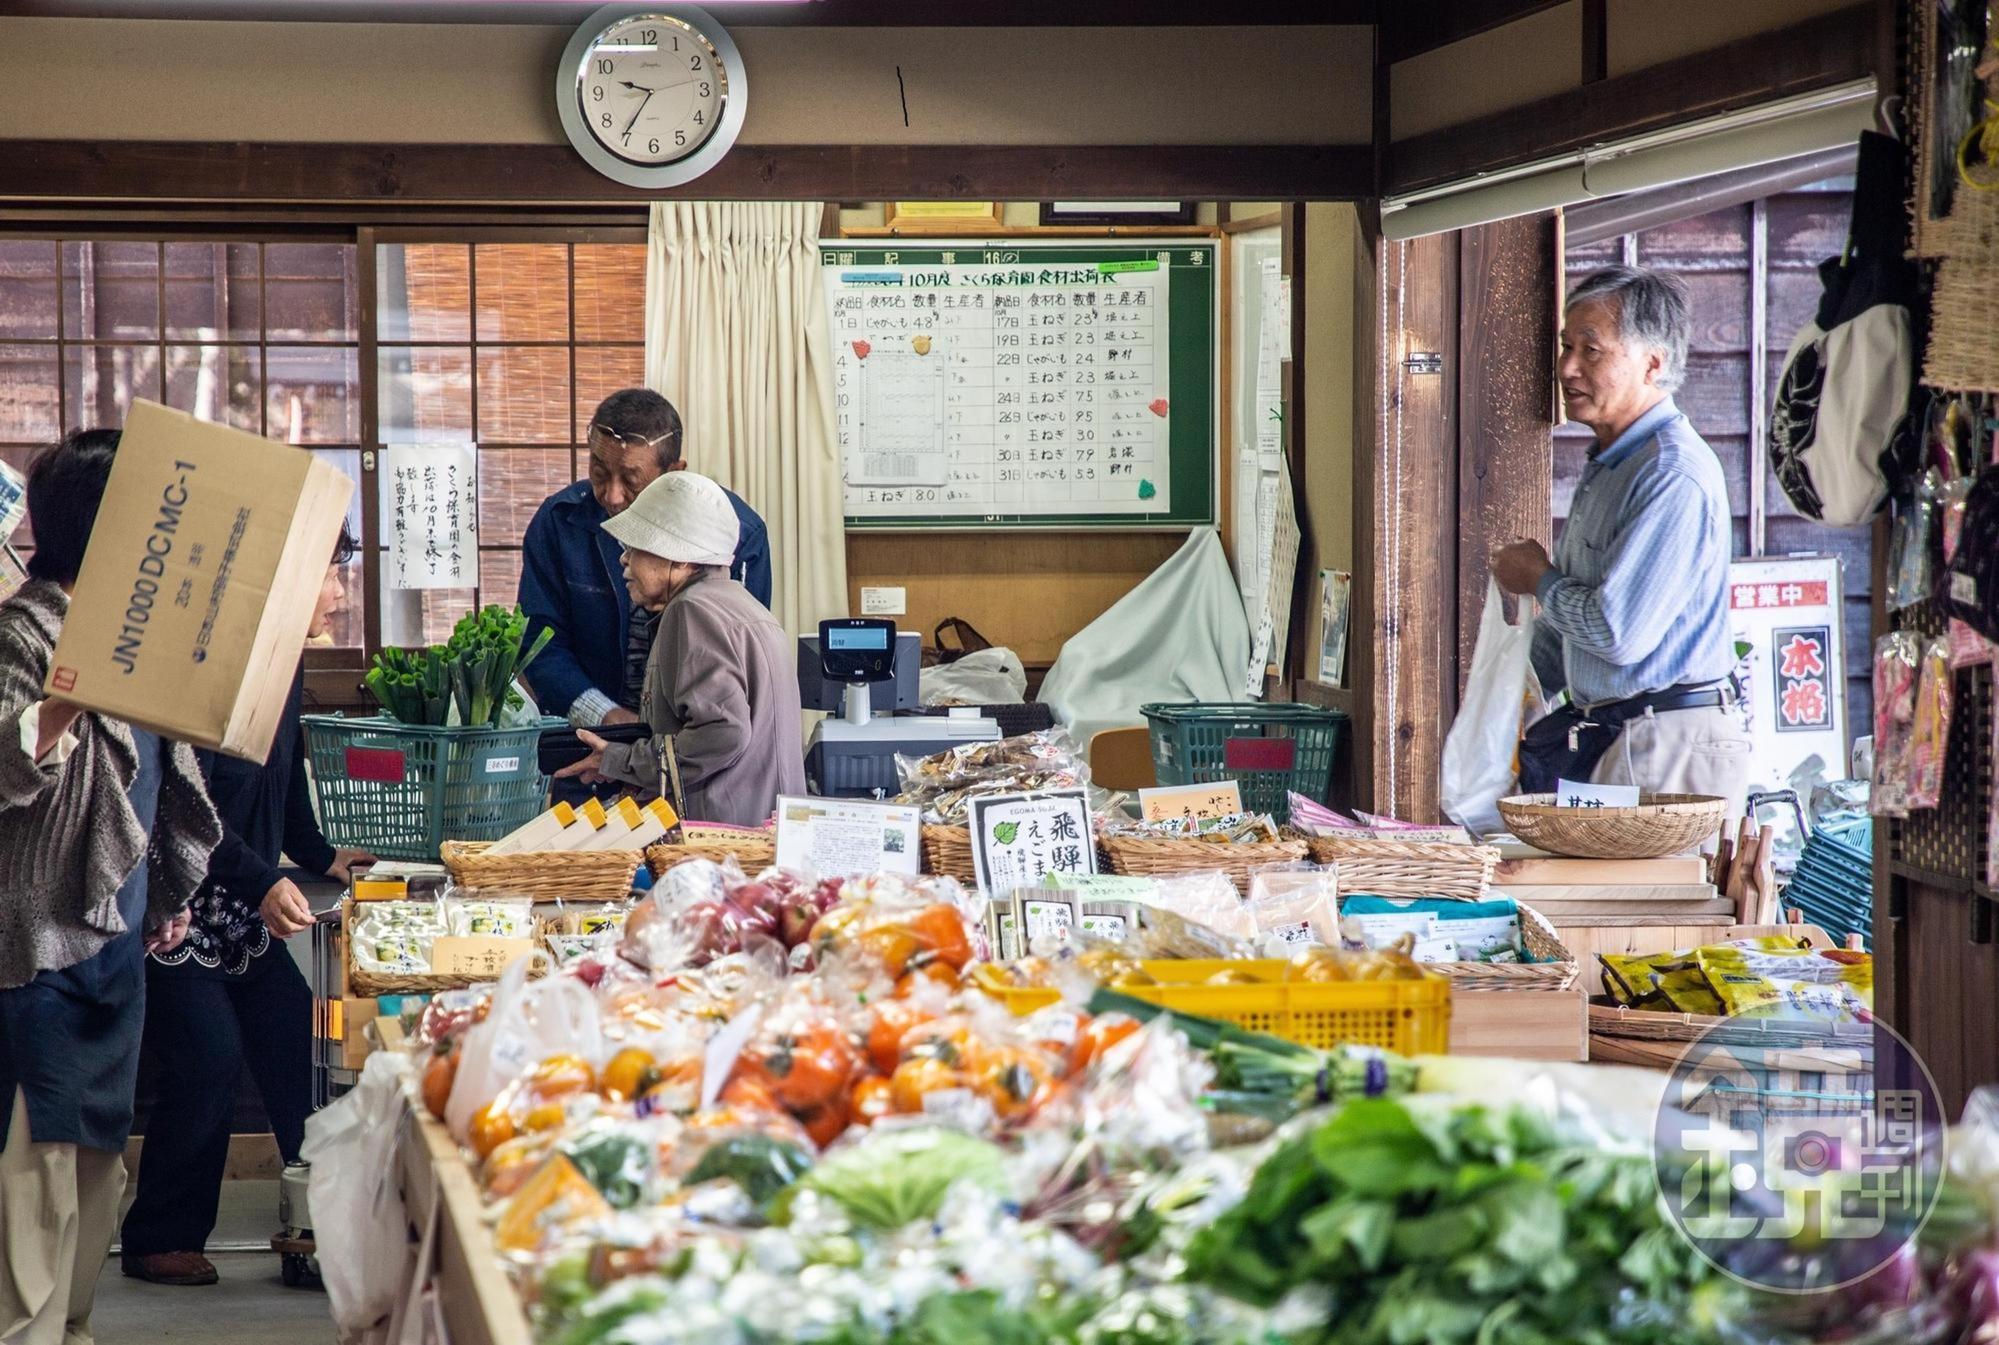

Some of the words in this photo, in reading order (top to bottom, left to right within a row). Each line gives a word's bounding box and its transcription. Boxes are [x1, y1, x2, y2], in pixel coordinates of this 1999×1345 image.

[641, 30, 658, 46] 12
[673, 37, 680, 51] 1
[598, 59, 613, 75] 10
[691, 56, 702, 71] 2
[593, 86, 604, 101] 9
[700, 82, 710, 97] 3
[602, 113, 612, 128] 8
[693, 110, 704, 125] 4
[621, 132, 631, 147] 7
[649, 138, 659, 154] 6
[675, 131, 685, 146] 5
[985, 252, 999, 265] 16
[912, 293, 937, 309] 数量
[944, 294, 984, 309] 生産者
[1027, 293, 1066, 307] 食材名
[1073, 291, 1097, 307] 数量
[1104, 292, 1146, 307] 生産者
[866, 316, 909, 329] じゃがいも
[996, 316, 1019, 328] 17日
[997, 335, 1019, 347] 19日
[997, 354, 1020, 365] 22日
[1027, 353, 1067, 365] じゃがいも
[997, 392, 1020, 404] 24日
[999, 412, 1021, 423] 26日
[997, 450, 1020, 461] 30日
[999, 469, 1021, 481] 31日
[1734, 583, 1803, 608] 営業中
[1781, 633, 1825, 725] 本格
[1027, 820, 1048, 877] えごま
[1050, 811, 1082, 872] 飛騨
